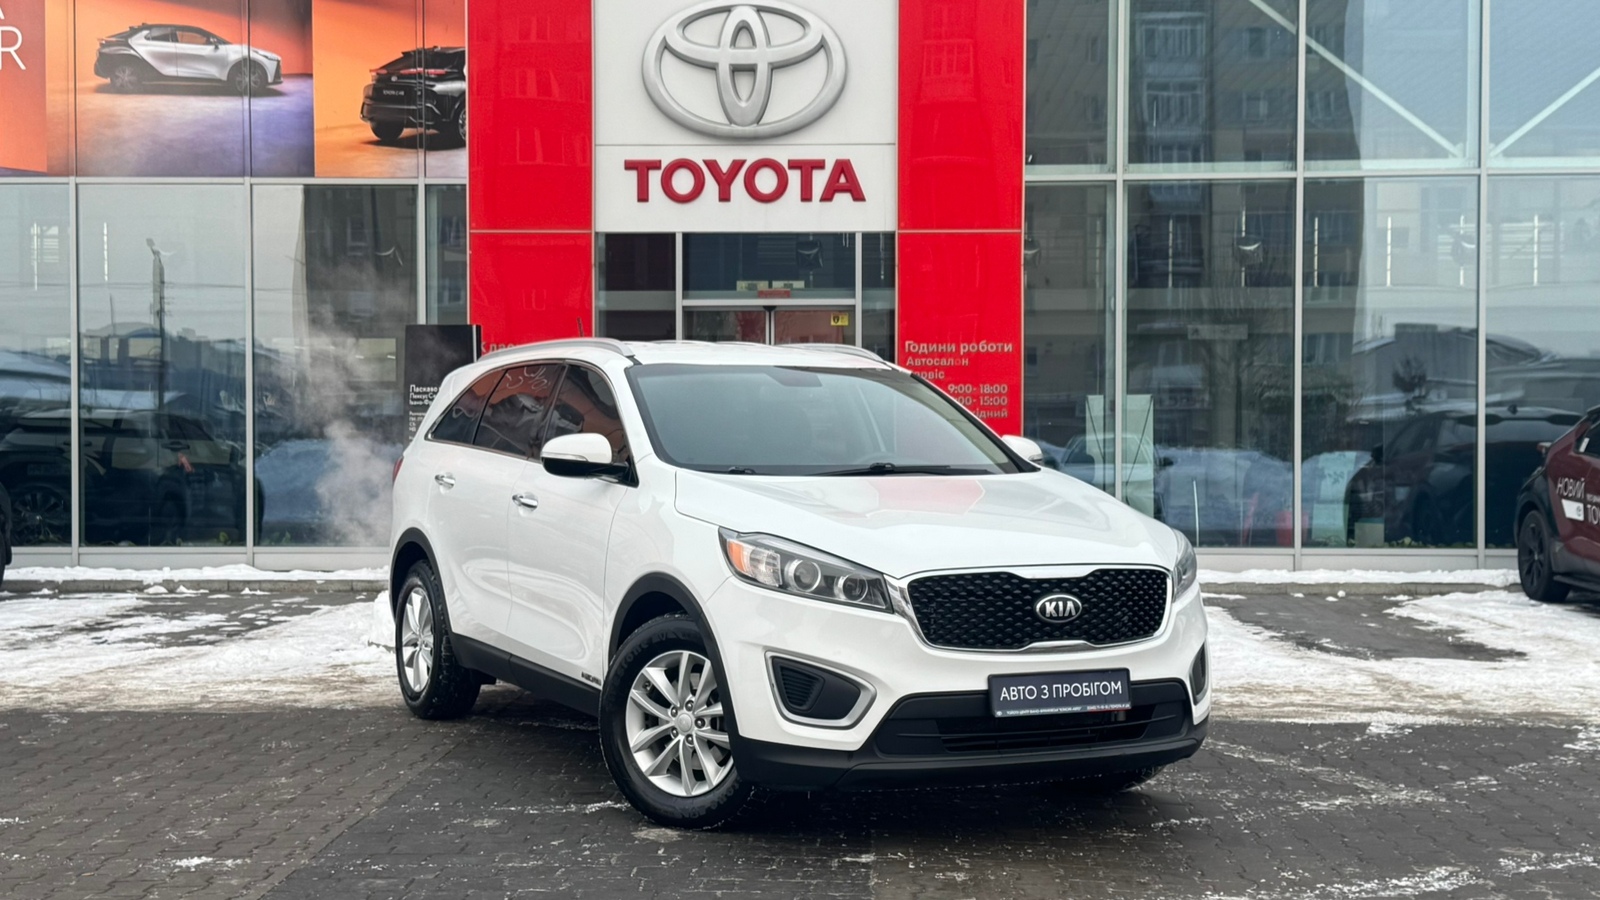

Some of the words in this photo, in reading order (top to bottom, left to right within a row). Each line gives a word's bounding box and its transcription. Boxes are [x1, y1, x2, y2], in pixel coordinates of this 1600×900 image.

[624, 157, 867, 204] TOYOTA
[904, 340, 956, 355] Години
[960, 340, 1012, 355] роботи
[1556, 476, 1585, 500] НОВИЙ
[1045, 600, 1076, 617] KIA
[1000, 685, 1037, 701] АВТО
[1052, 680, 1122, 698] ПРОБІГОМ
